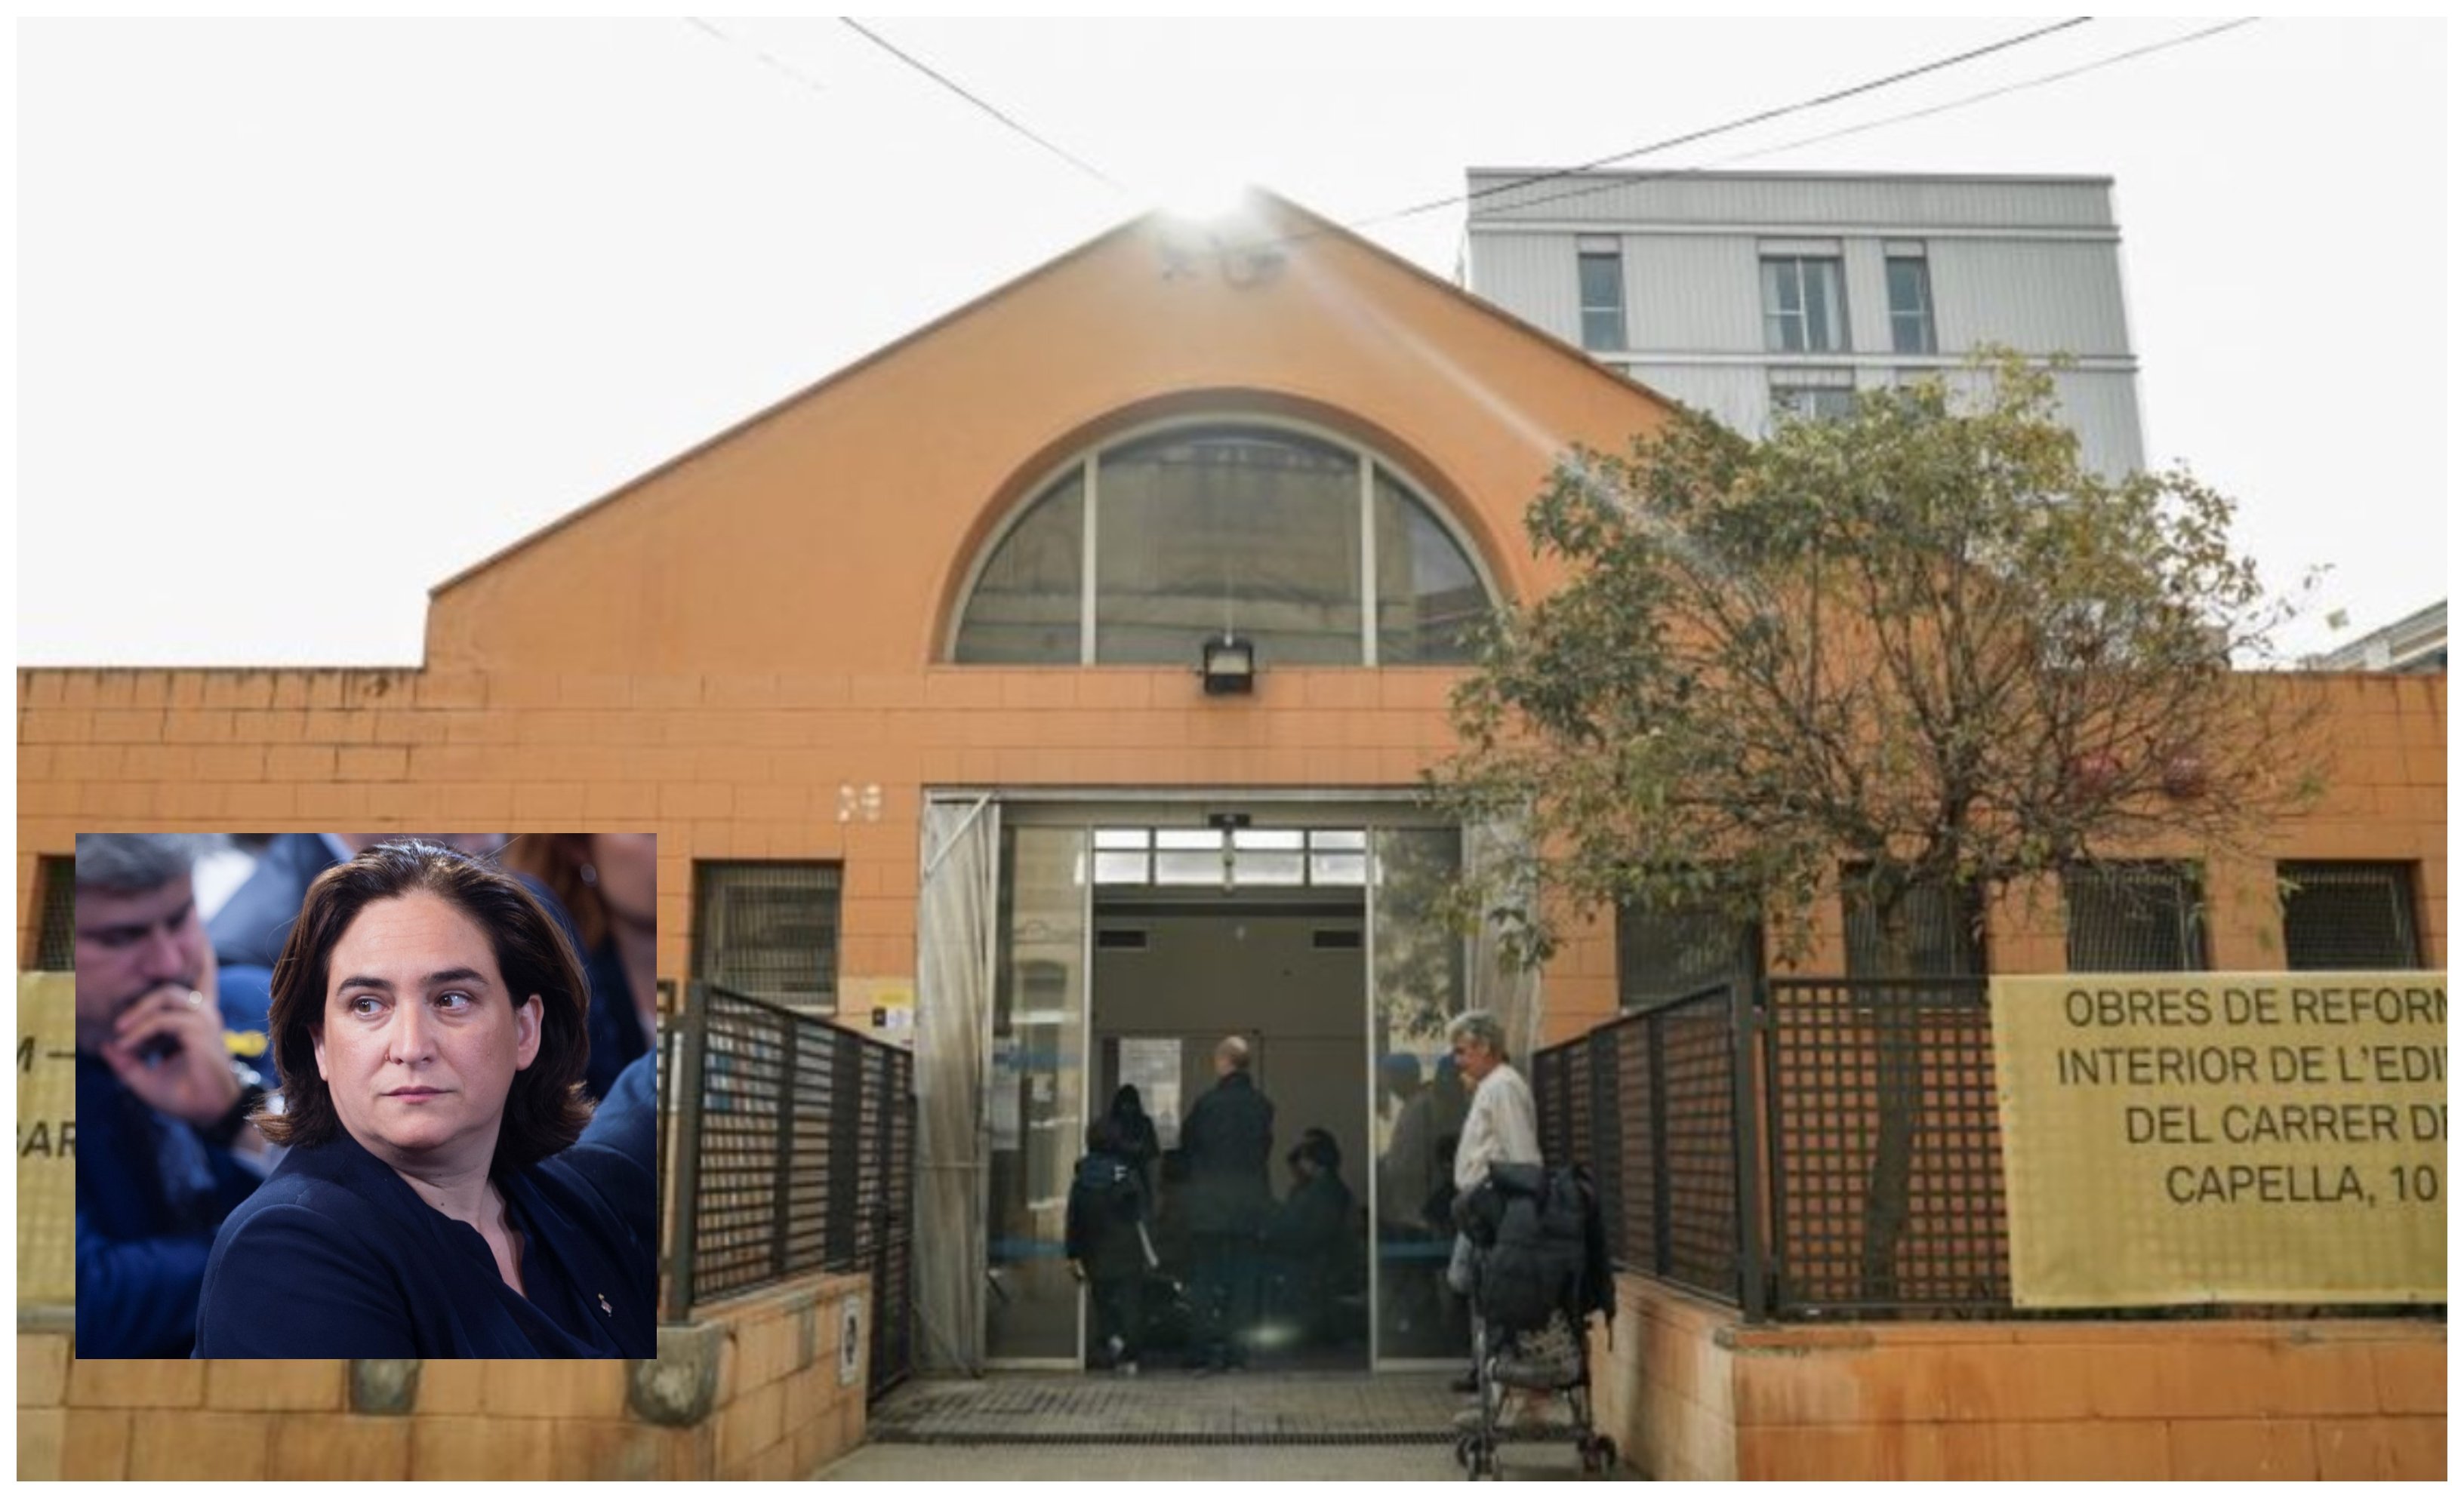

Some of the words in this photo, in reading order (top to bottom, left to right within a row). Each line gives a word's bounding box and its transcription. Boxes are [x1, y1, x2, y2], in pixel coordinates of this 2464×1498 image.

[2065, 989, 2213, 1027] OBRES
[2224, 989, 2281, 1026] DE
[2058, 1046, 2259, 1085] INTERIOR
[2270, 1046, 2328, 1084] DE
[2338, 1045, 2447, 1083] L'EDI
[2126, 1106, 2213, 1144] DEL
[2222, 1105, 2400, 1144] CARRER
[2166, 1164, 2376, 1207] CAPELLA,
[2390, 1164, 2439, 1202] 10
